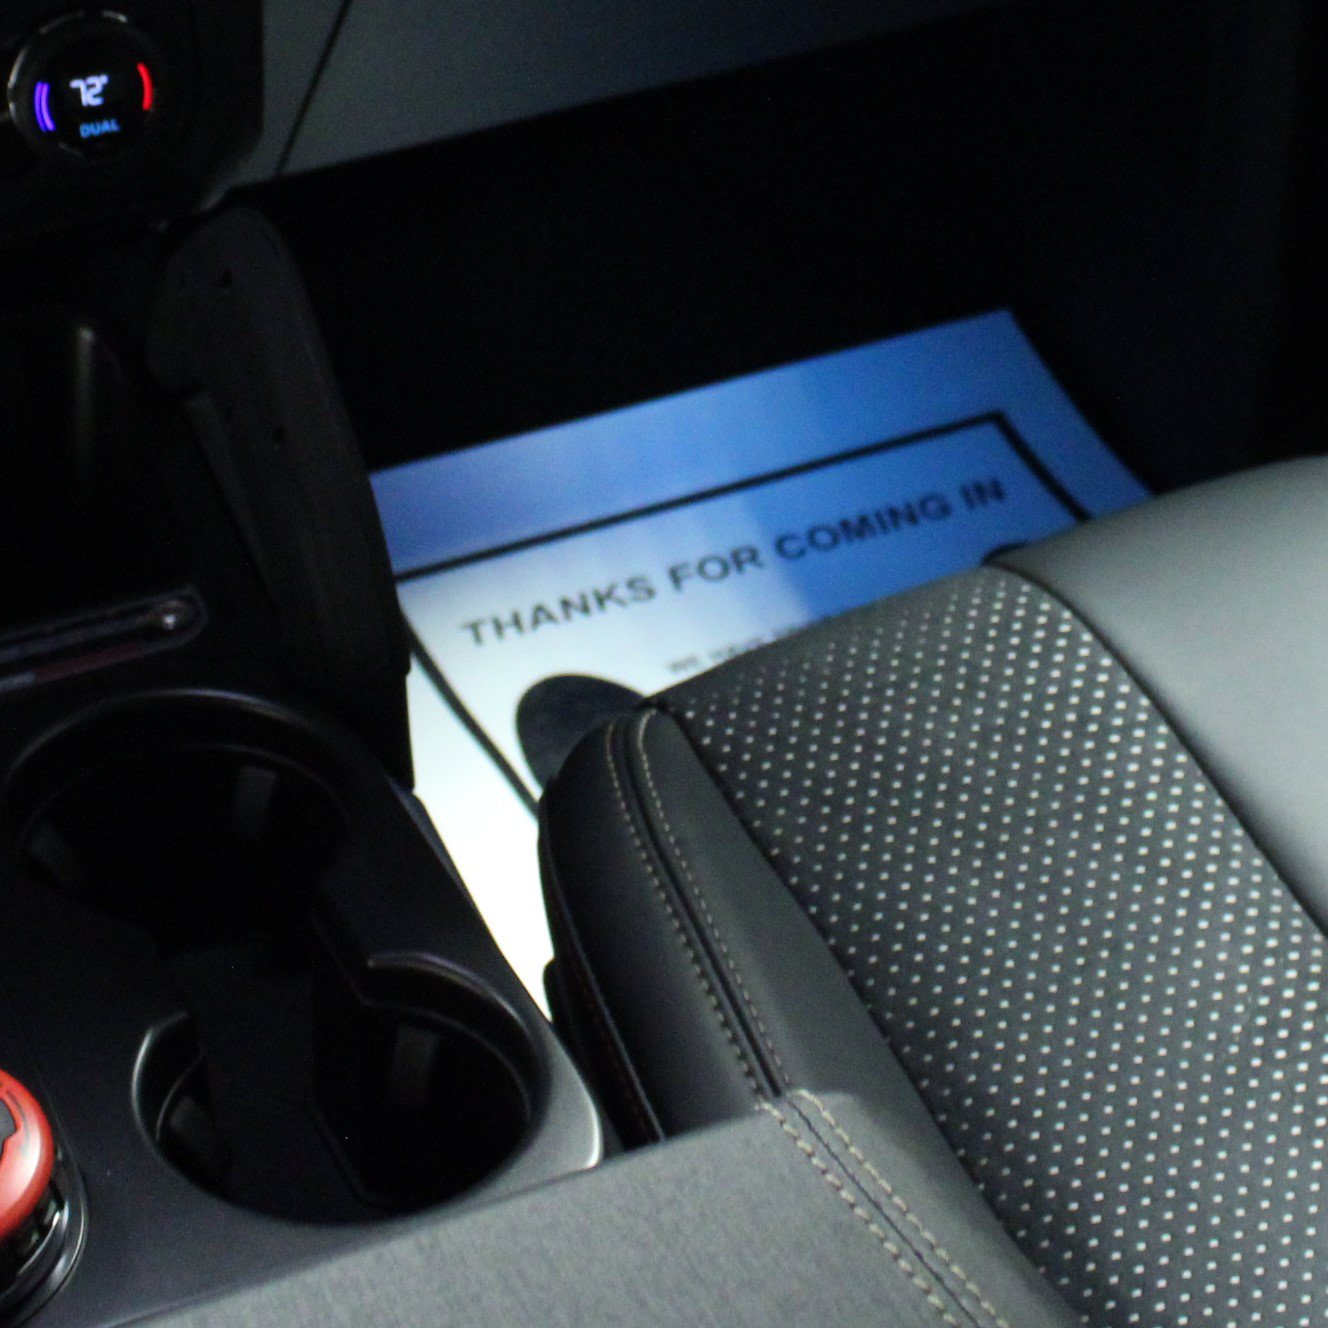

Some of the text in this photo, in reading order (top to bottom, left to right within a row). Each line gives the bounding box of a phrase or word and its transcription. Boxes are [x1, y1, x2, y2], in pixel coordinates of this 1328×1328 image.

[79, 118, 121, 139] DUAL
[462, 575, 658, 649] THANKS
[667, 544, 767, 594] FOR
[772, 489, 953, 563] COMING
[959, 475, 1009, 516] IN
